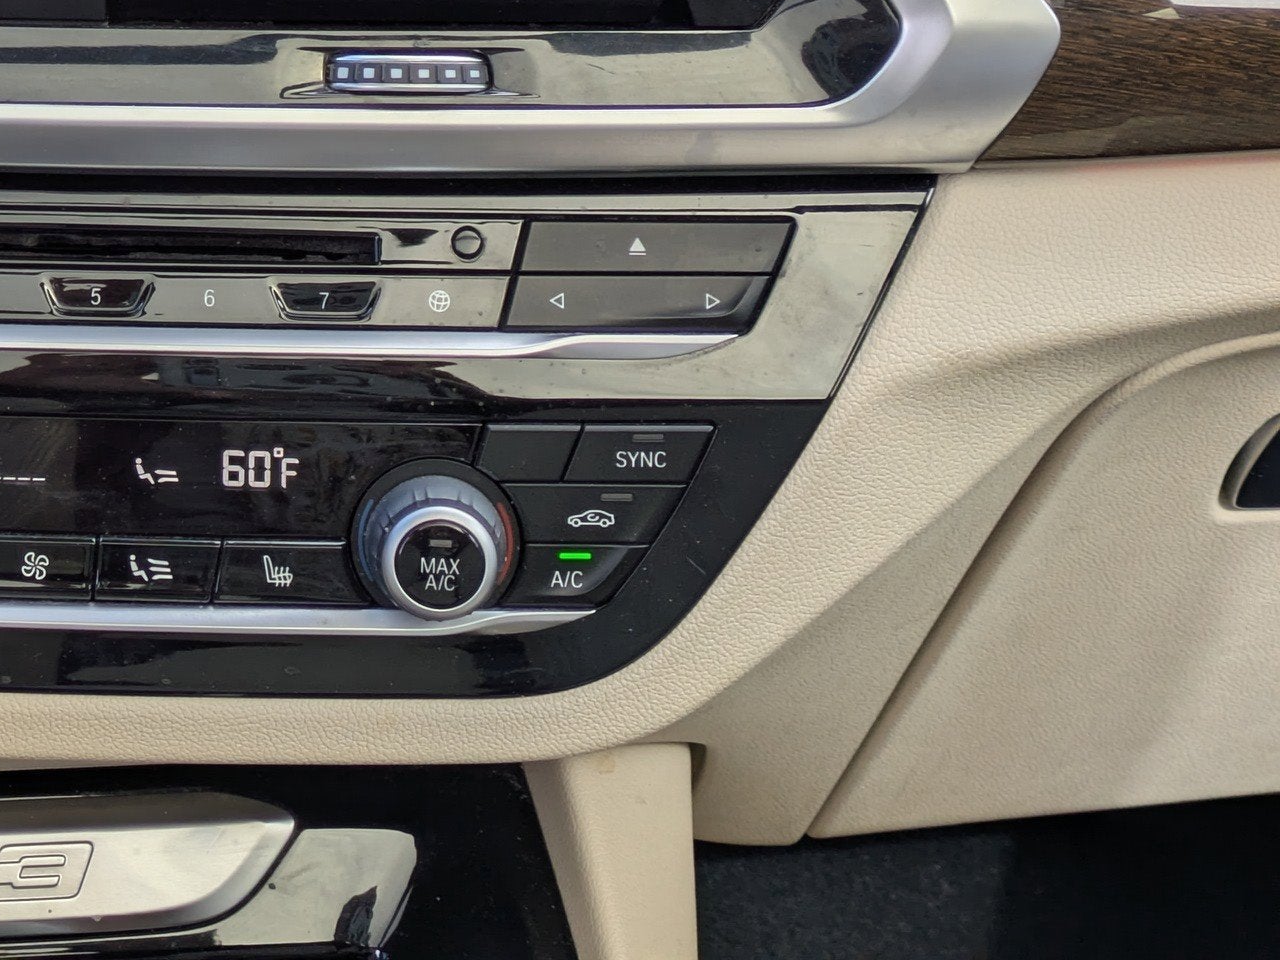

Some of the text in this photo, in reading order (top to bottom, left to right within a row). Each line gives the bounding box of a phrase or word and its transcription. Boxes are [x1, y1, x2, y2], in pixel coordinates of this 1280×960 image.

[89, 285, 102, 307] 5
[204, 289, 215, 307] 6
[318, 290, 330, 310] 7
[615, 450, 667, 468] SYNC
[420, 557, 461, 575] MAX
[424, 574, 457, 592] A/C
[550, 570, 583, 589] A/C
